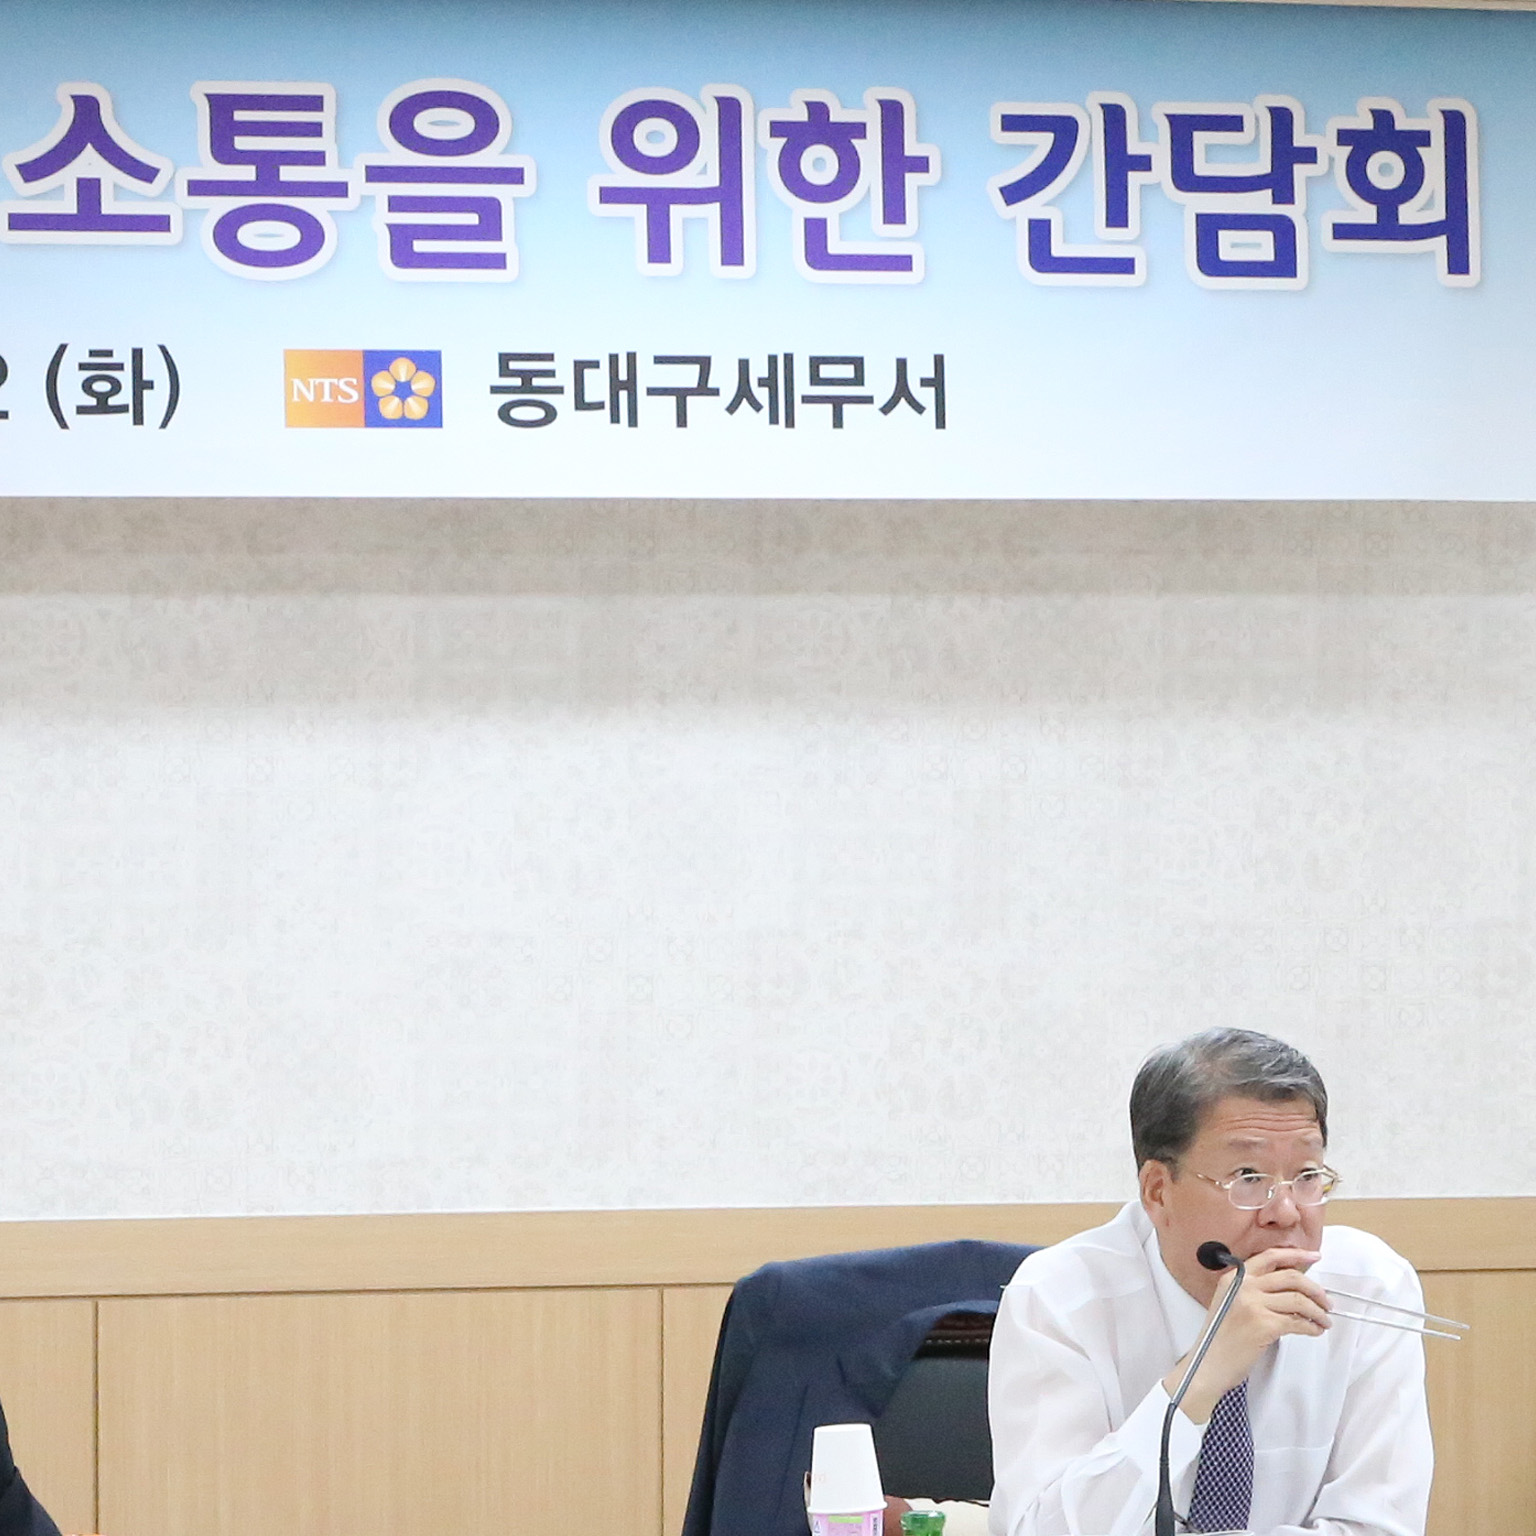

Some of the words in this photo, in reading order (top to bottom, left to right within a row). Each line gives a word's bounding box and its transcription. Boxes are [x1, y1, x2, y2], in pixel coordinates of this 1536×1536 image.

[4, 88, 527, 271] 소통을
[596, 94, 932, 273] 위한
[996, 100, 1472, 280] 간담회
[44, 343, 181, 430] (화)
[291, 377, 360, 404] NTS
[488, 350, 947, 431] 동대구세무서
